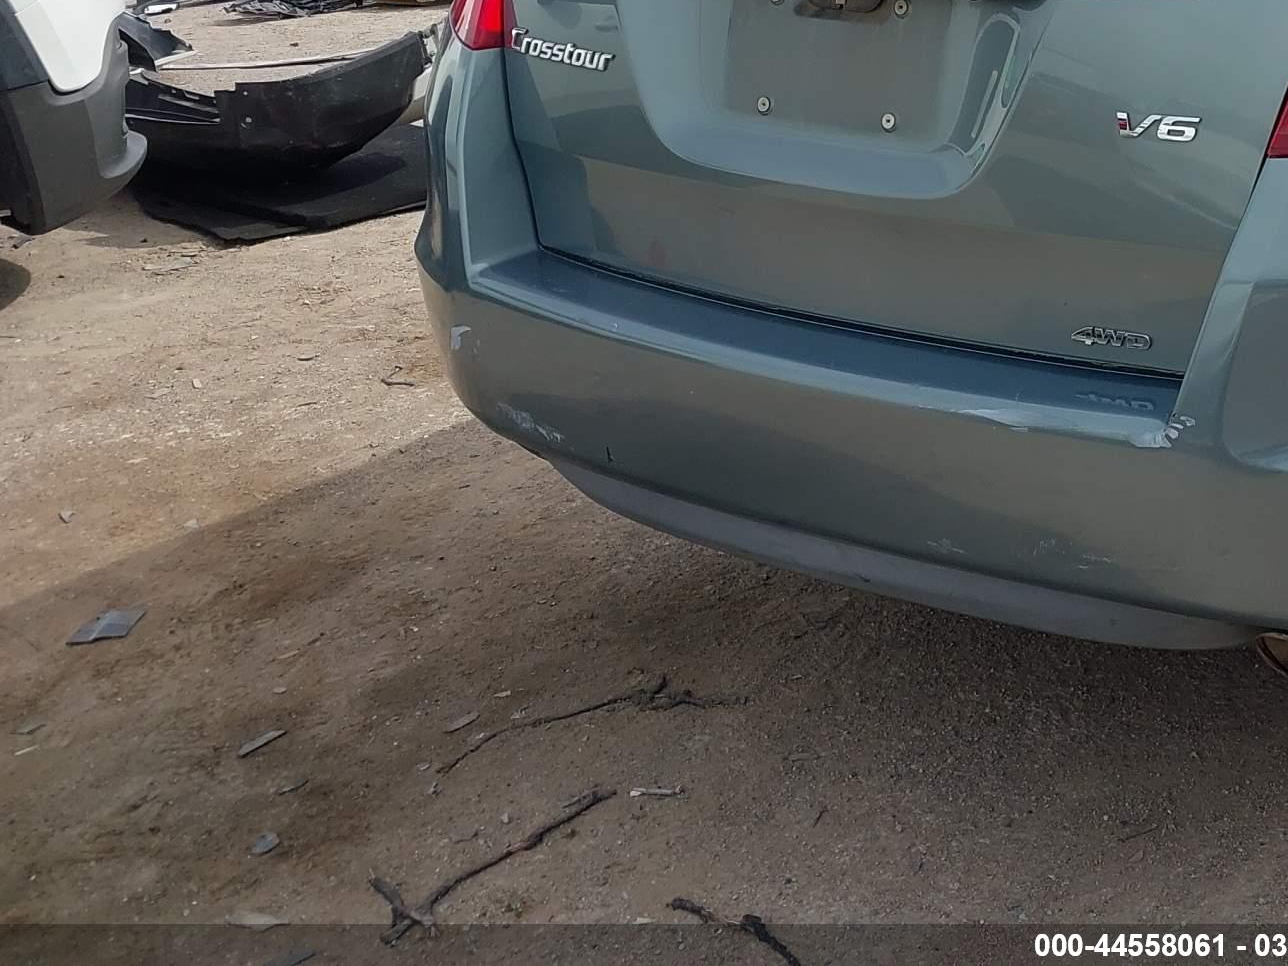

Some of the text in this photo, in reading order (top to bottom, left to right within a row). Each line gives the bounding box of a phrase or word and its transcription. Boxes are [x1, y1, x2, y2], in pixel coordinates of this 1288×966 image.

[511, 26, 616, 72] Crosstour
[1116, 112, 1201, 142] V6
[1071, 326, 1152, 350] 4WD
